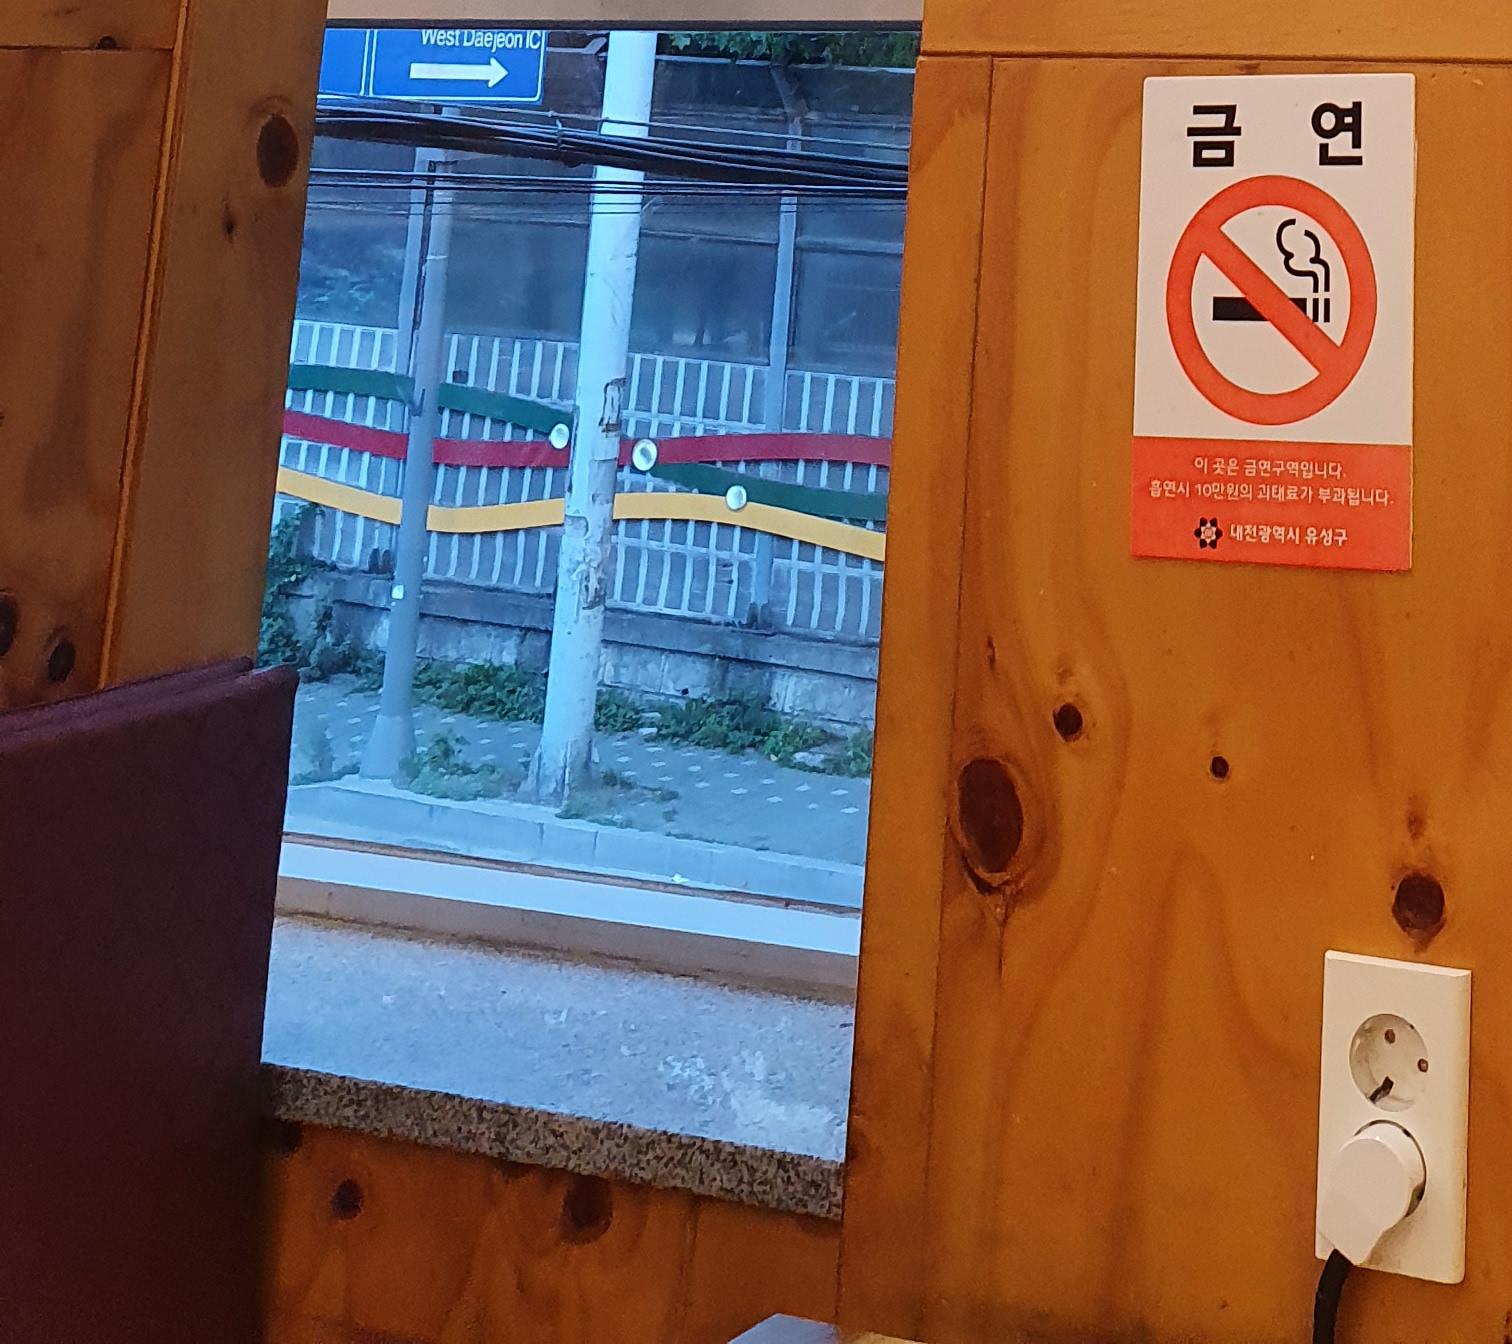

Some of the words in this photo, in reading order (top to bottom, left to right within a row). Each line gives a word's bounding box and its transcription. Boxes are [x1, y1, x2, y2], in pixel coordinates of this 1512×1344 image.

[421, 29, 460, 47] West
[463, 29, 523, 53] Daejeon
[525, 30, 541, 49] IC
[1193, 457, 1208, 475] 이
[1212, 458, 1239, 476] 곳은
[1243, 459, 1347, 480] 금연구역입니다.
[1149, 479, 1190, 498] 흡연시
[1195, 483, 1253, 502] 10만원의
[1257, 484, 1313, 504] 과태료가
[1317, 487, 1395, 507] 부과됩니다.
[1230, 523, 1300, 545] 대전광역시
[1304, 526, 1348, 547] 유성구
